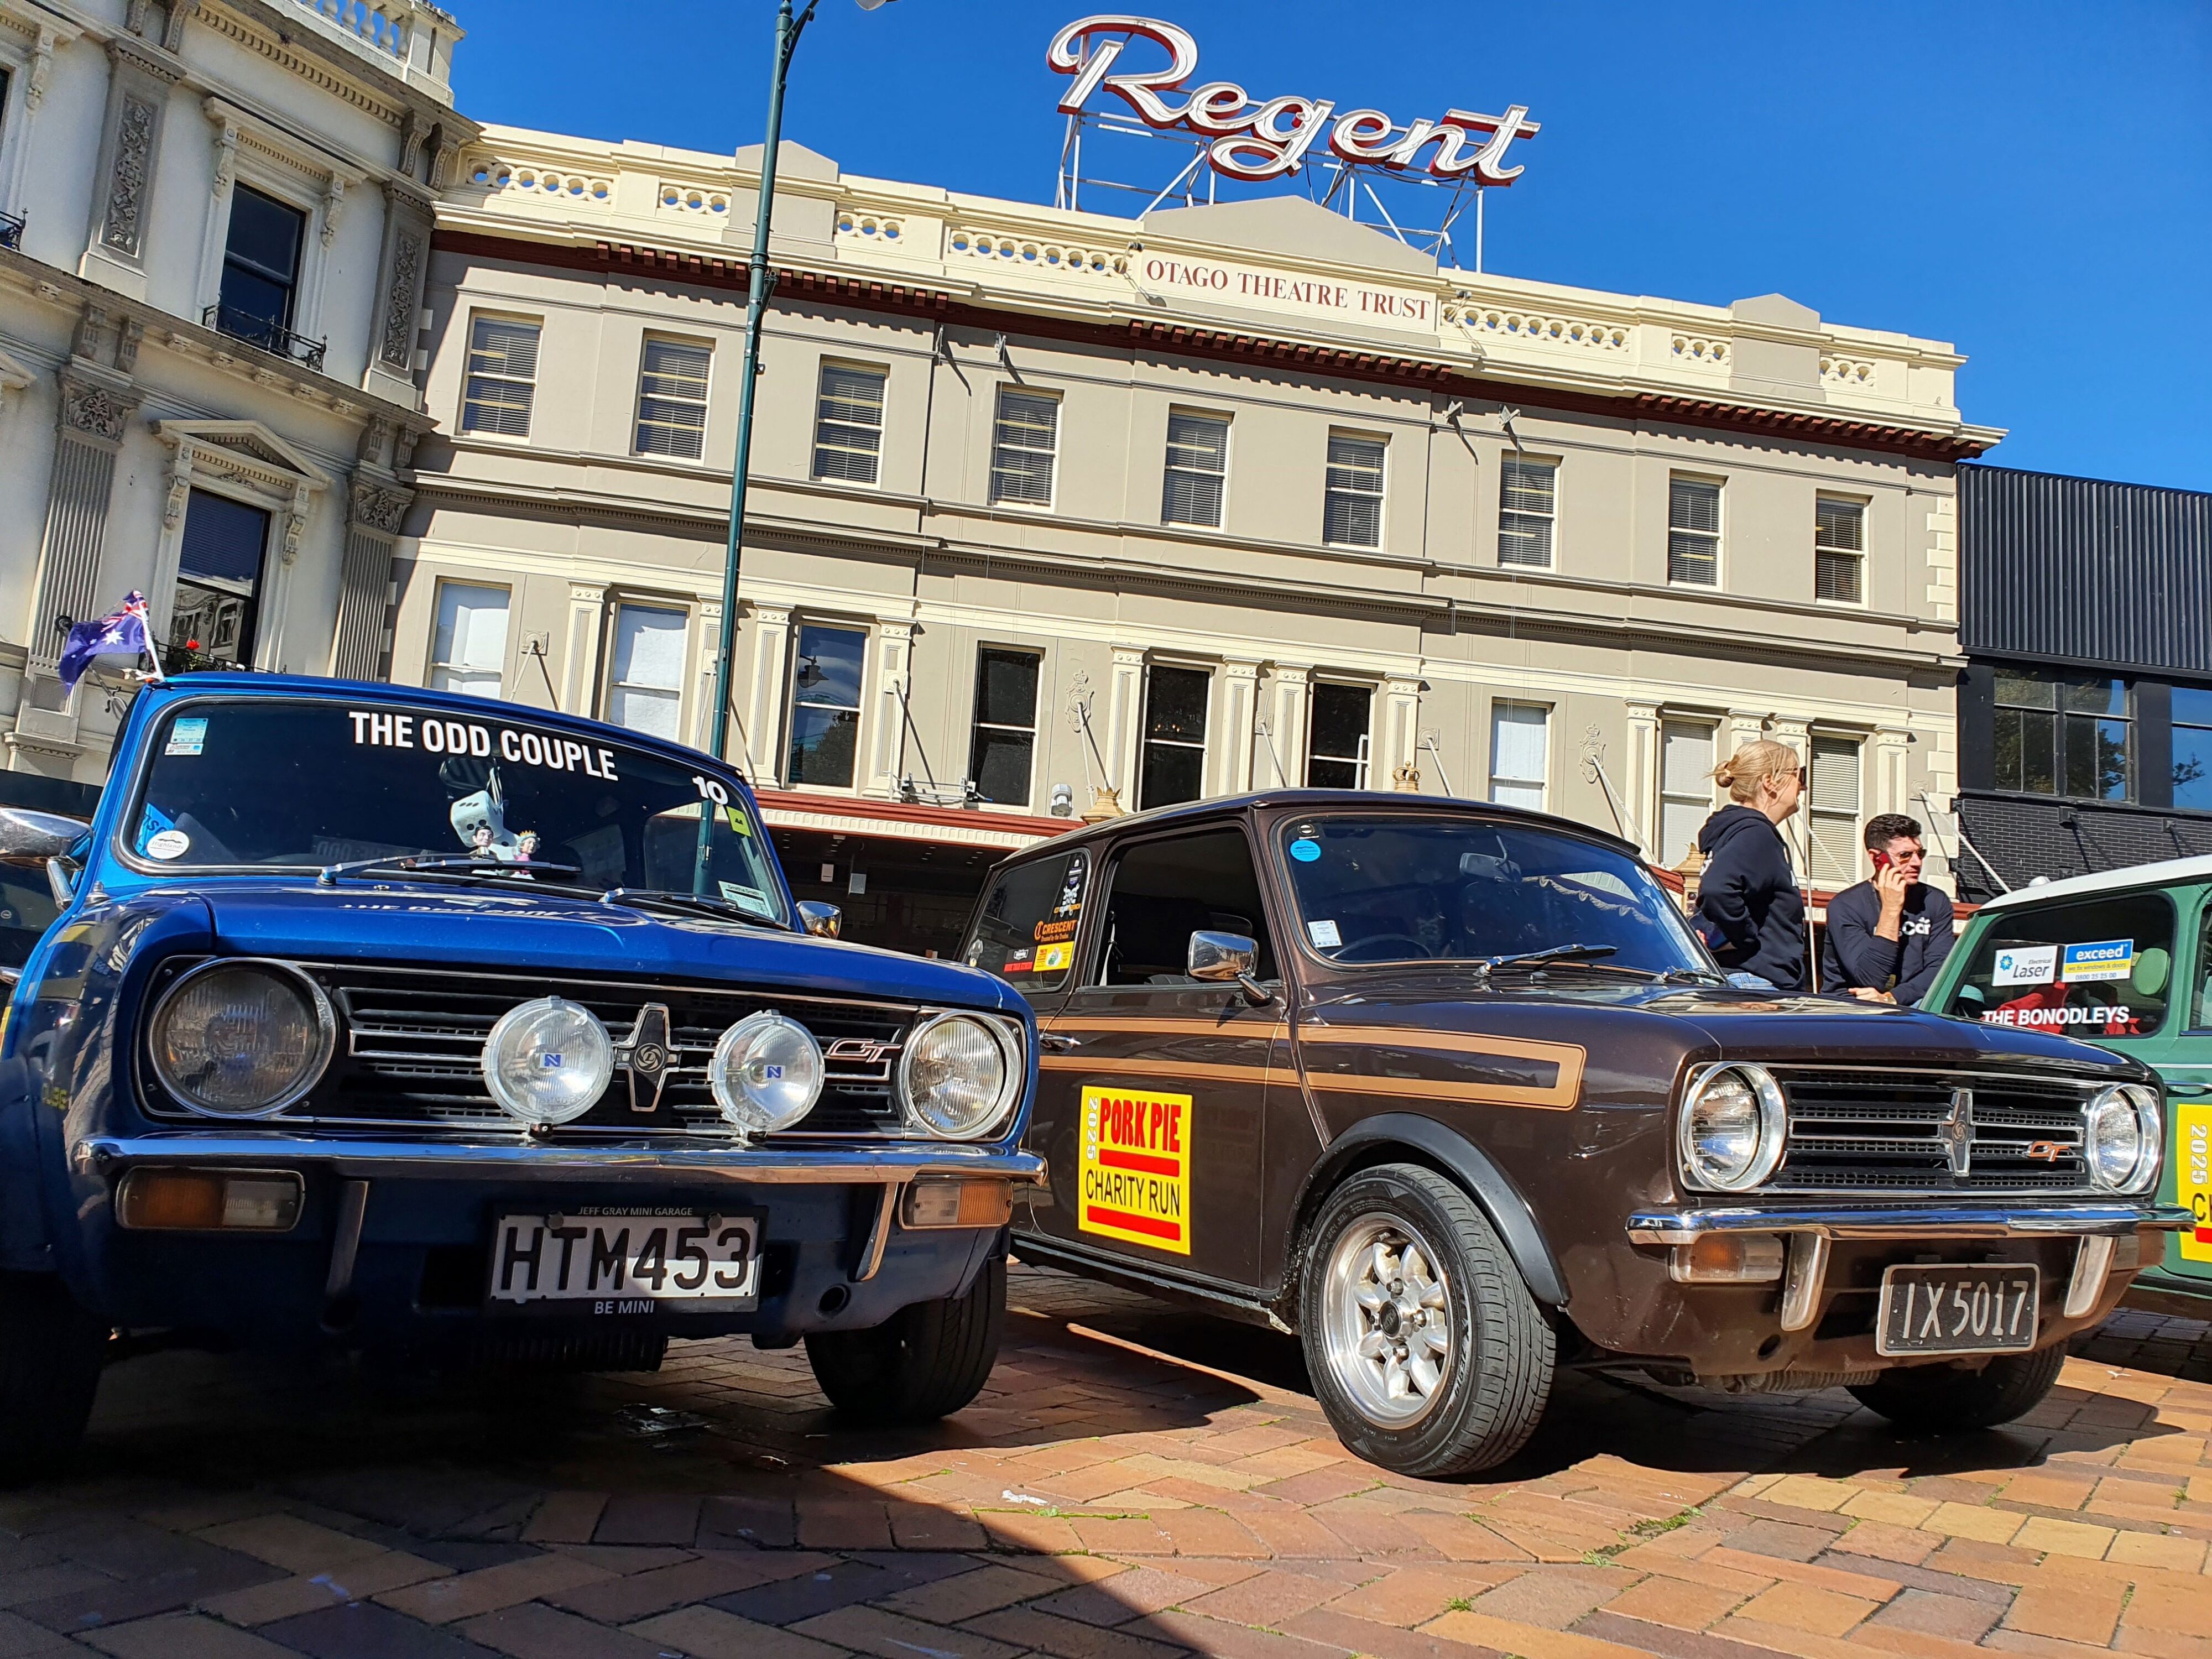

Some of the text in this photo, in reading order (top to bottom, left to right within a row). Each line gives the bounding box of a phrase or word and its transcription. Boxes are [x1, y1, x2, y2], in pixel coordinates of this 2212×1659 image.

[1046, 15, 1541, 186] Regent
[1147, 260, 1431, 320] OTAGO THEATRE TRUST
[348, 711, 619, 781] THE ODD COUPLE
[692, 776, 728, 805] 10
[1042, 920, 1077, 934] CRESCENT
[2012, 964, 2049, 978] Laser
[2076, 944, 2124, 961] exceed
[1982, 1006, 2130, 1025] THE BONODLEYS
[1086, 1095, 1099, 1160] 2025
[1099, 1097, 1181, 1152] PORK PIE
[2190, 1124, 2208, 1185] 2025
[578, 1207, 601, 1215] JEFF
[602, 1207, 629, 1215] GRAY
[655, 1207, 693, 1215] GARAGE
[1086, 1168, 1180, 1217] CHARITY RUN
[500, 1227, 751, 1290] HTM453
[594, 1301, 654, 1314] BE MINI
